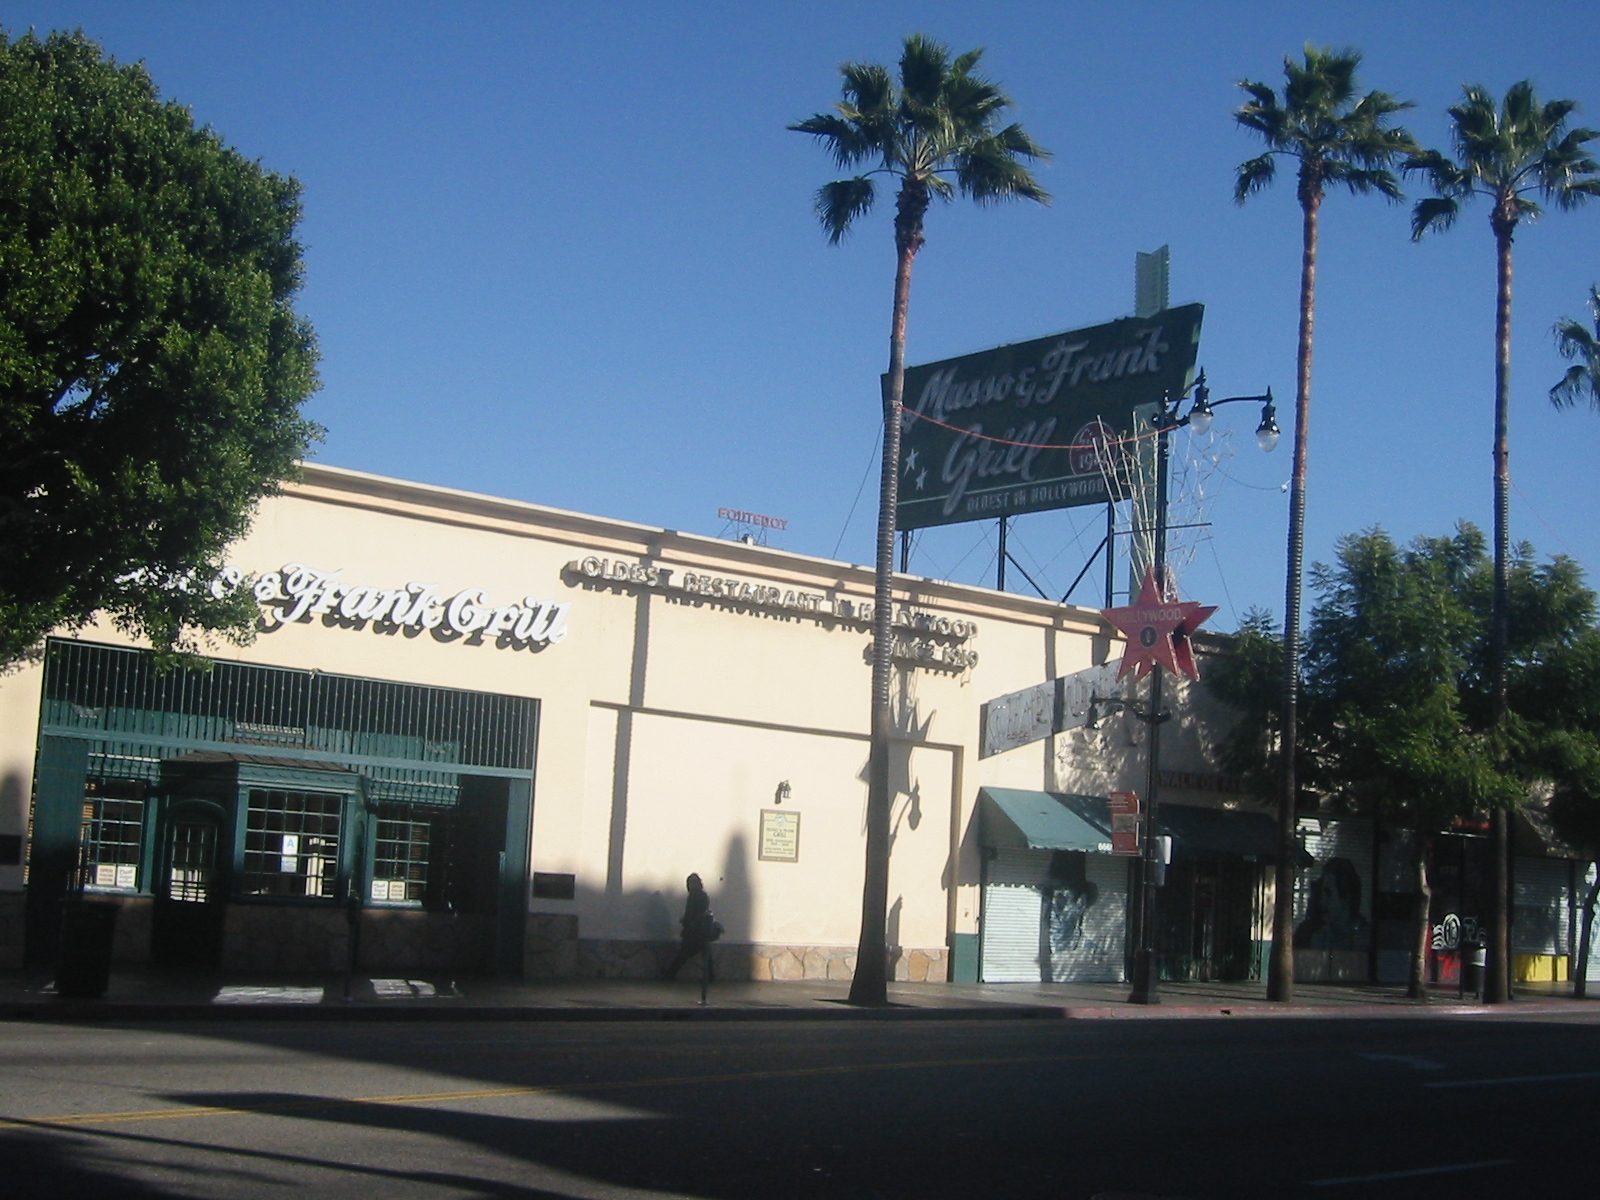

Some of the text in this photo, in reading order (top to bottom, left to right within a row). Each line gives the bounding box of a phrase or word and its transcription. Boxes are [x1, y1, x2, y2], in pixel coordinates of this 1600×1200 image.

[901, 366, 1014, 434] Musso
[1038, 325, 1170, 401] Frank
[941, 416, 1057, 516] Grill
[966, 478, 1105, 513] OLDEST IN HOLLYWOOD
[274, 562, 445, 628] Frank
[447, 585, 574, 644] Grill
[582, 555, 673, 587] OLDEST
[683, 571, 825, 613] RESTAURANT
[833, 599, 855, 618] IN
